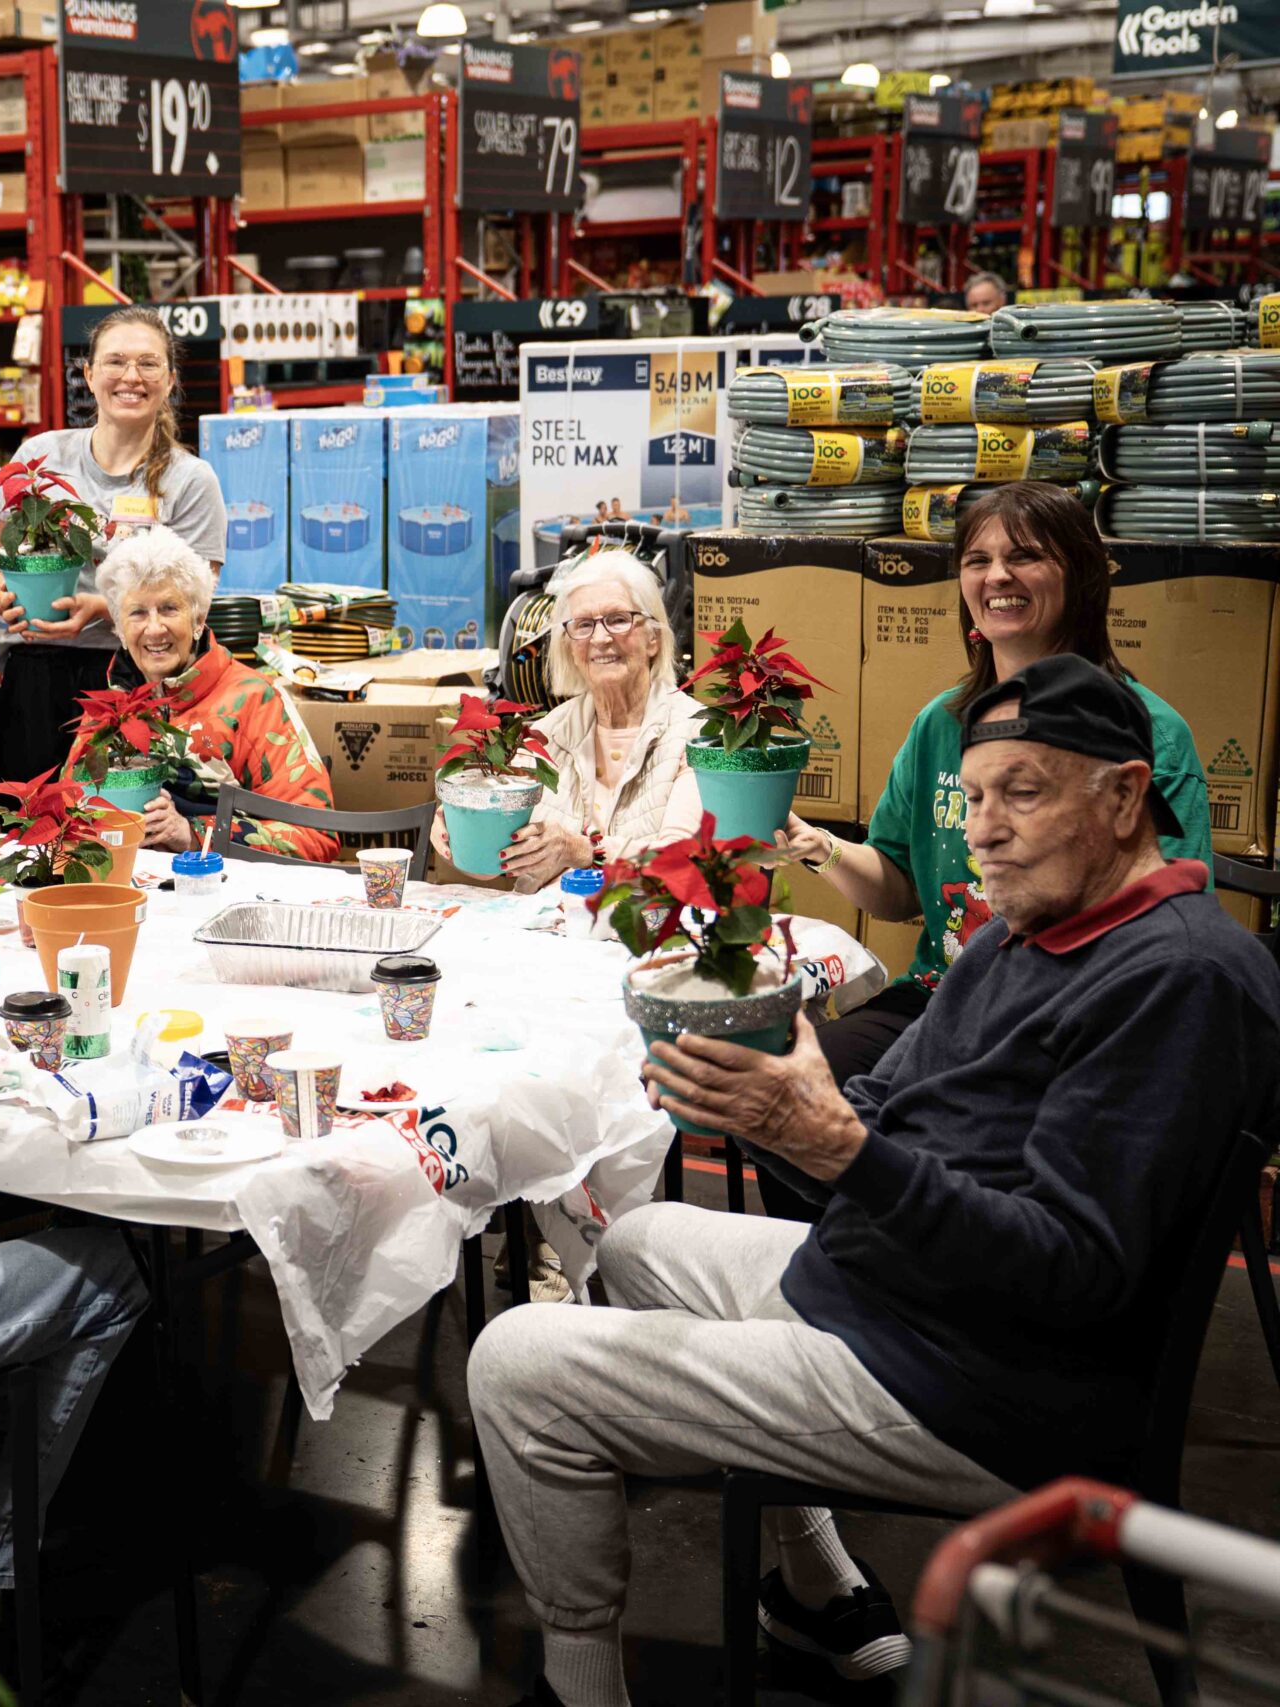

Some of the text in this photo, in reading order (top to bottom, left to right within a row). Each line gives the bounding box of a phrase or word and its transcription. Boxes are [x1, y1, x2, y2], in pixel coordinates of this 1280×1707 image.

[1141, 1, 1238, 31] Garden
[1140, 28, 1201, 57] Tools
[173, 305, 209, 336] 30
[556, 300, 588, 328] 29
[535, 365, 603, 386] Bestway
[696, 371, 712, 393] M
[532, 420, 586, 440] STEEL
[532, 445, 618, 466] PRO MAX
[698, 552, 730, 566] 100
[878, 561, 914, 575] 100
[699, 596, 713, 604] ITEM
[877, 606, 894, 614] ITEM
[902, 616, 907, 624] 5
[914, 617, 929, 625] PCS
[914, 626, 929, 635] KGS
[914, 636, 929, 645] KGS
[1114, 639, 1142, 649] TAIWAN
